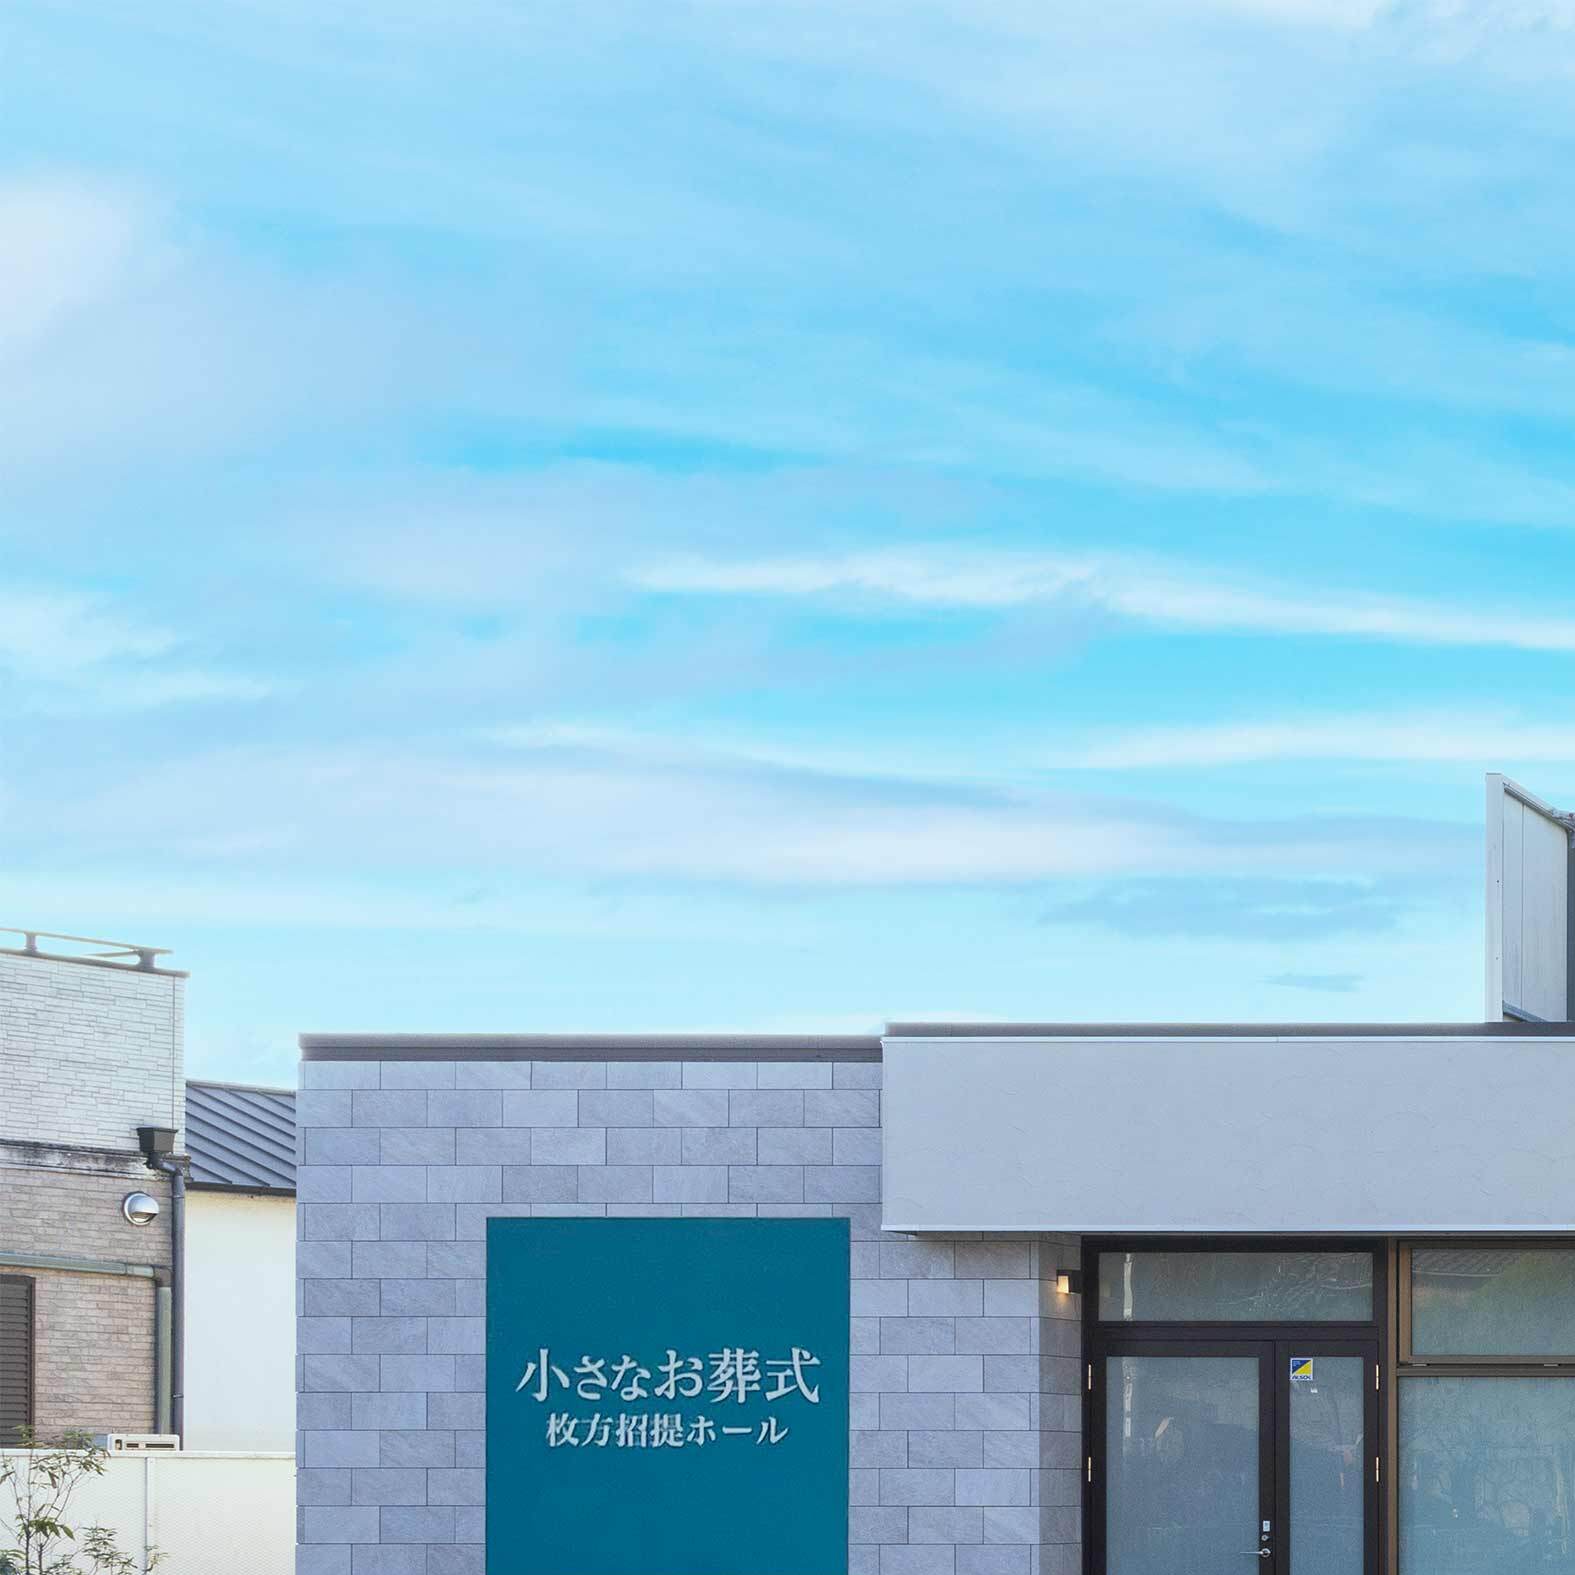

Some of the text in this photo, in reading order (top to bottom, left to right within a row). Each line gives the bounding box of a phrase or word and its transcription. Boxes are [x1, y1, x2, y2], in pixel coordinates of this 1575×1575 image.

[517, 1347, 820, 1403] 小さなお葬式
[547, 1413, 788, 1447] 枚方招提ホール
